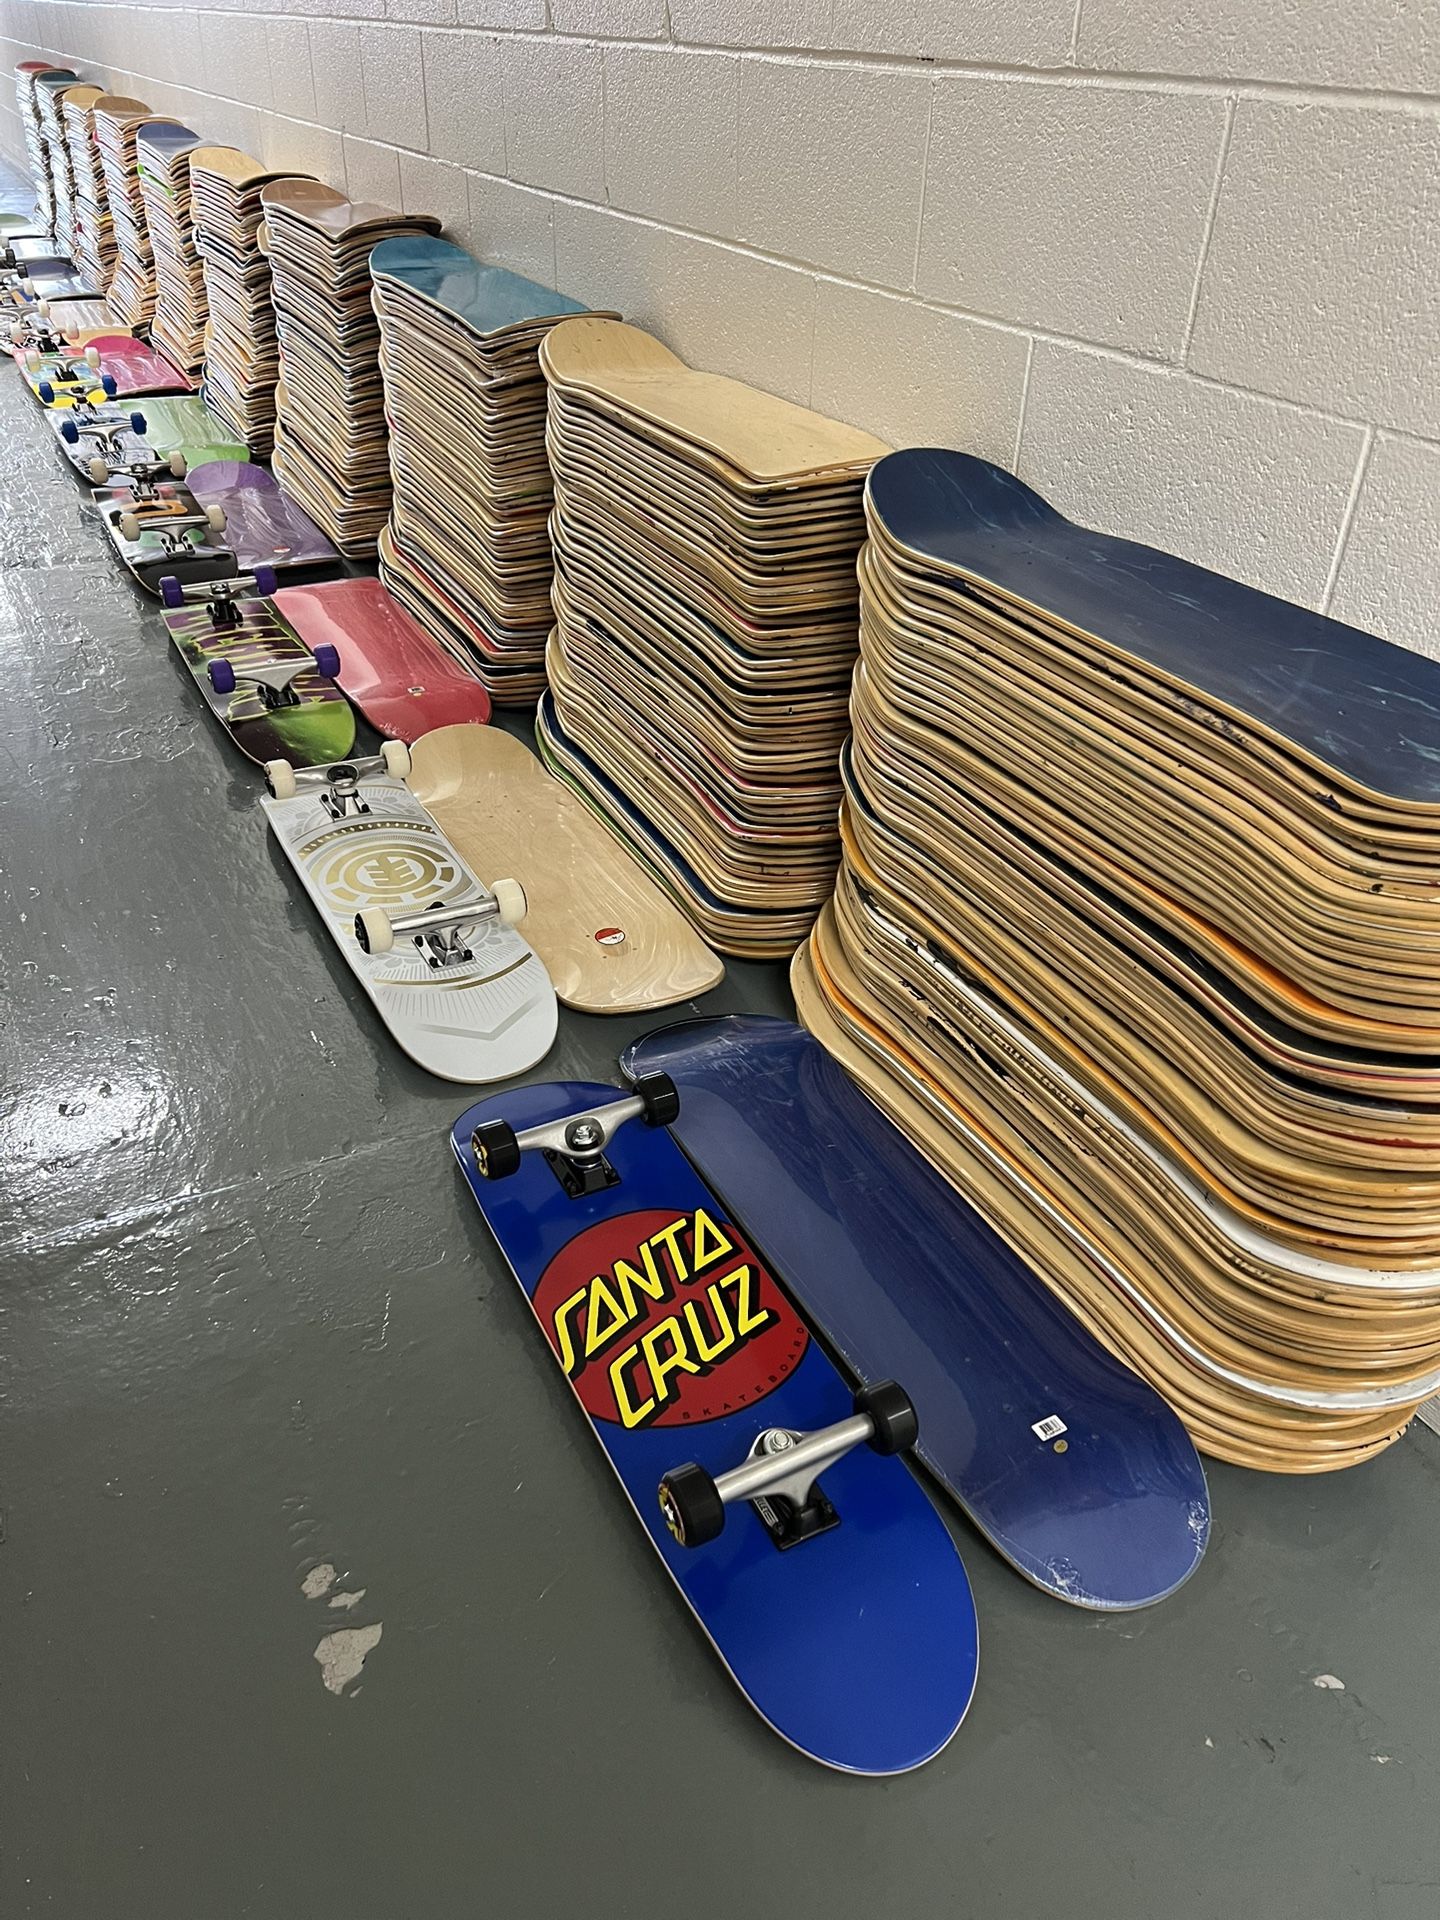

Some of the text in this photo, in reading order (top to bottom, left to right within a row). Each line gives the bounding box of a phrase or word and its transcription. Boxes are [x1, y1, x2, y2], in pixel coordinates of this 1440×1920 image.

[554, 1208, 736, 1376] SANTA
[609, 1264, 772, 1429] CRUZ
[682, 1327, 805, 1420] SKATEBOARD
